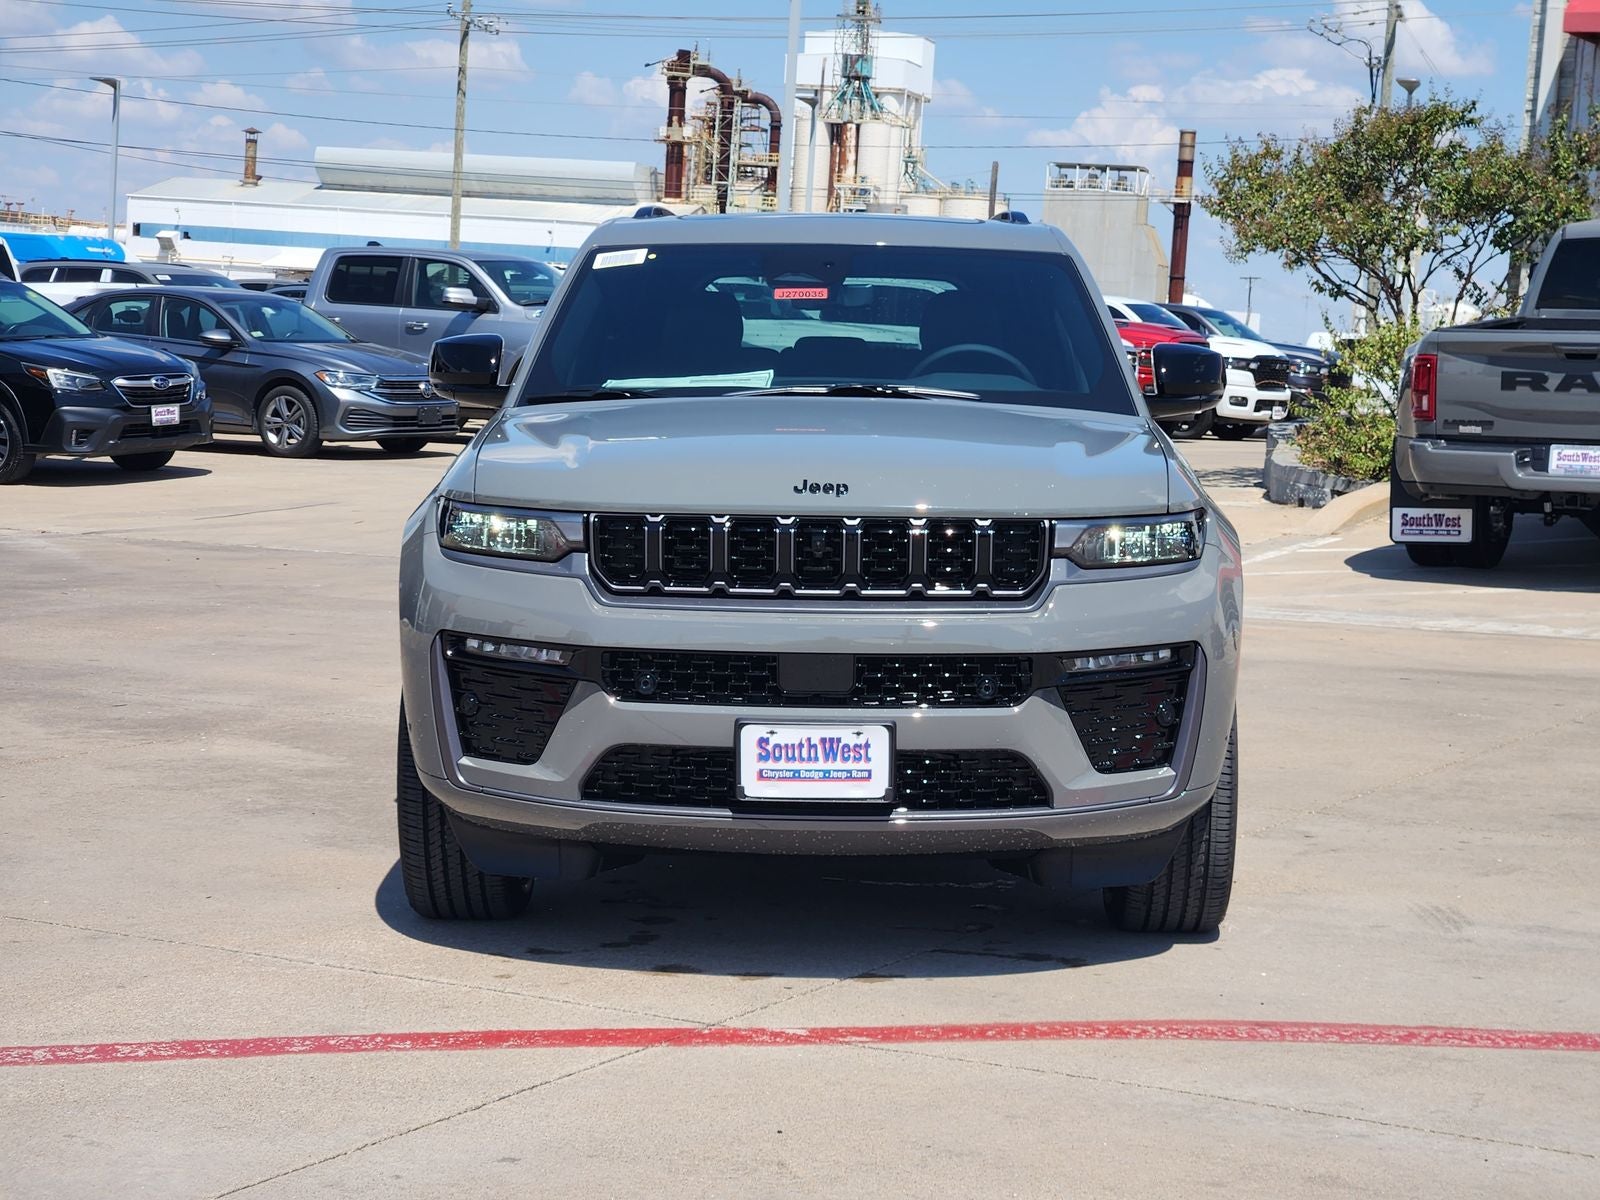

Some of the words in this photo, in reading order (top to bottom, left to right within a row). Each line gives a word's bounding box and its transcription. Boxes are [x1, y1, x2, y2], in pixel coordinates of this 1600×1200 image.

[779, 290, 825, 298] J270035
[793, 479, 849, 497] Jeep
[1400, 513, 1462, 528] SouthWest
[757, 736, 872, 763] SouthWest
[762, 769, 794, 779] Chrysler
[800, 769, 824, 779] Dodge
[829, 769, 847, 779] Jeep
[851, 770, 869, 778] Ram
